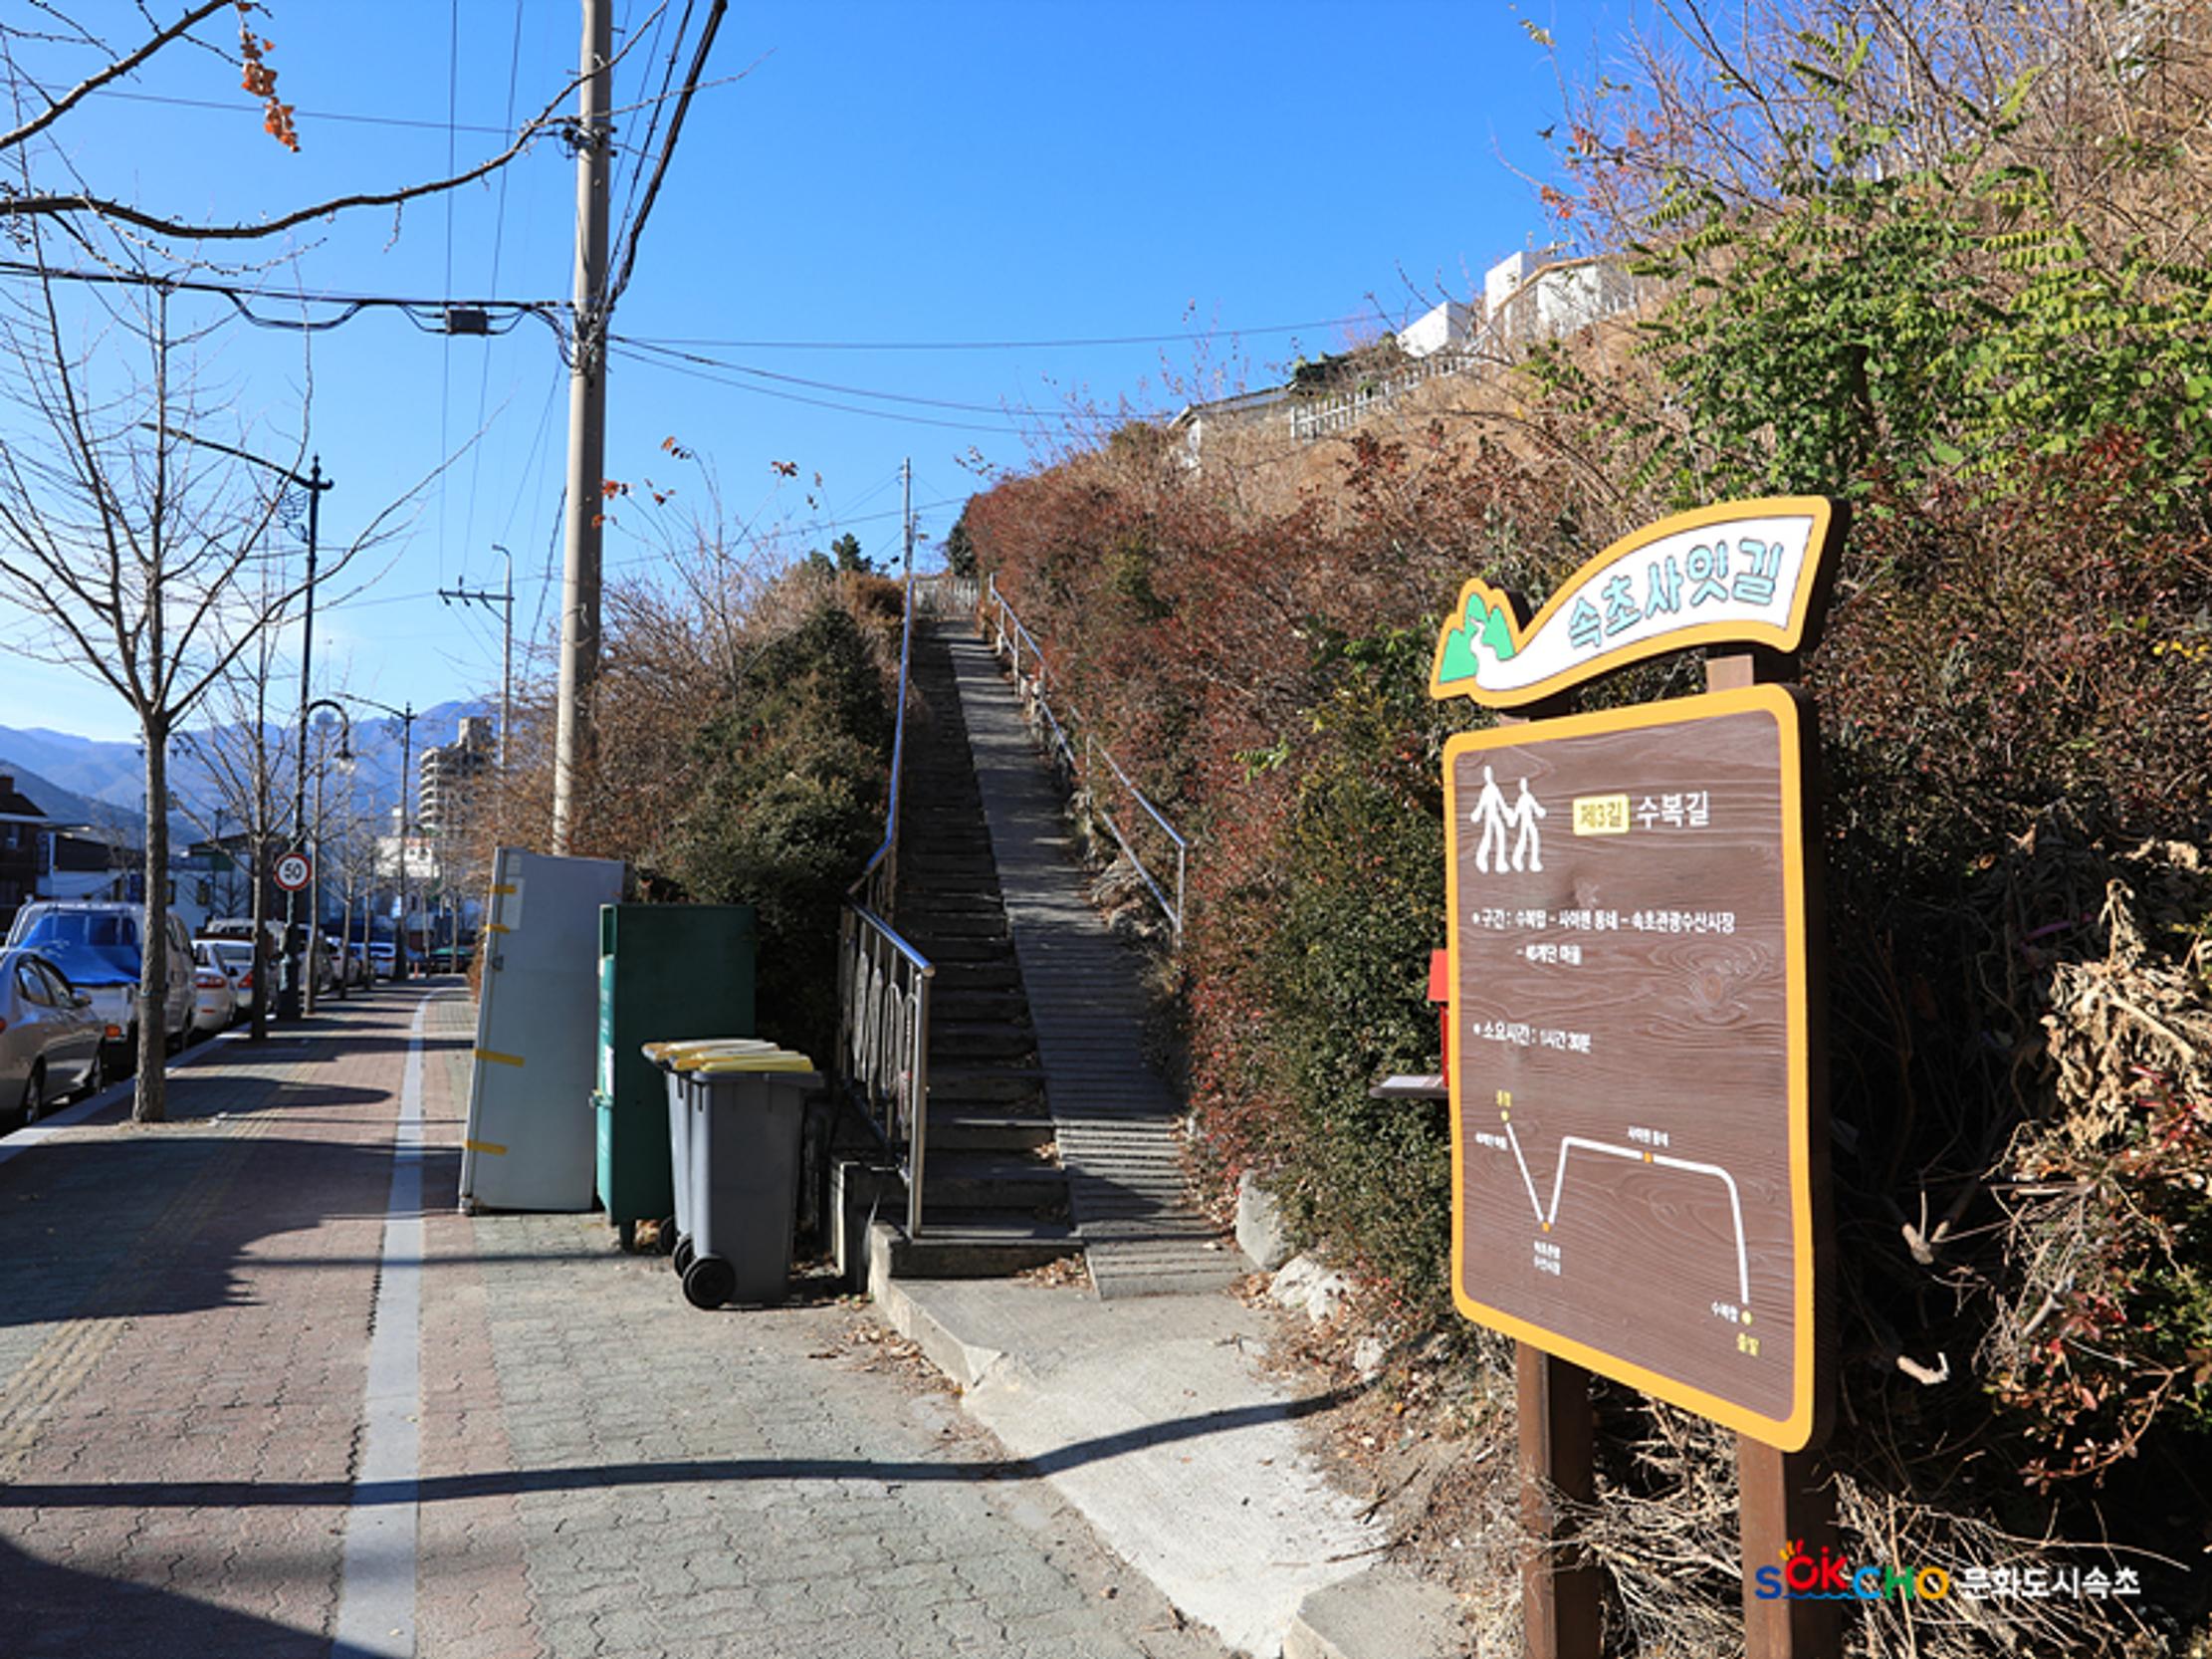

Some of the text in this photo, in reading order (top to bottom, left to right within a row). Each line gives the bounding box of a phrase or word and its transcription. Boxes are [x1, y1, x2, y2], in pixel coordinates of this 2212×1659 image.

[1568, 537, 1784, 649] 속초사잇길
[1579, 790, 1710, 830] 제3길 수복길
[285, 862, 303, 880] 50
